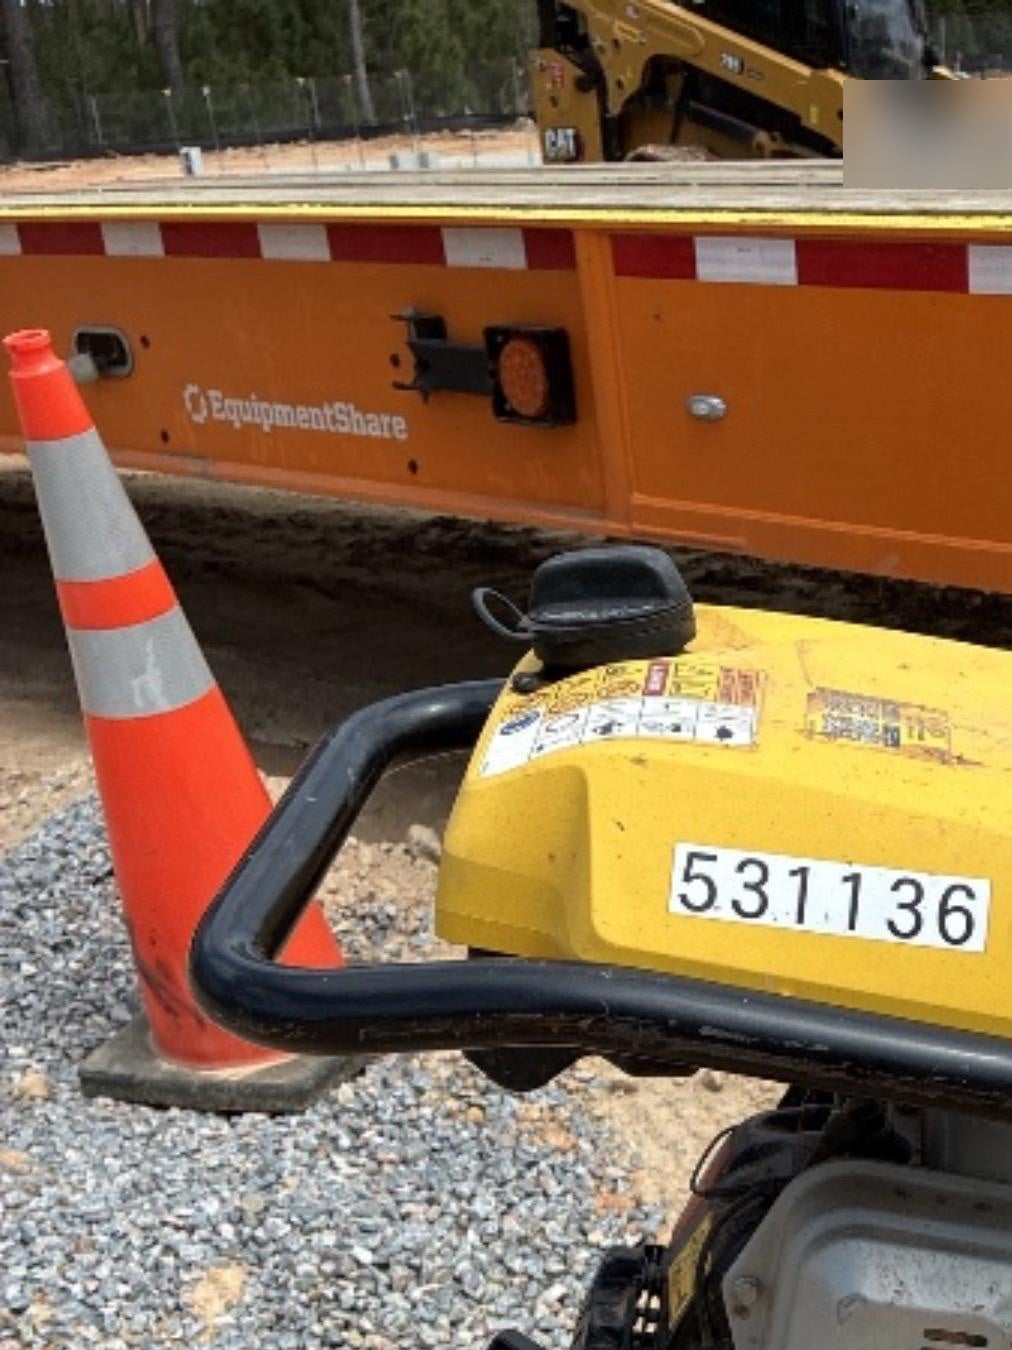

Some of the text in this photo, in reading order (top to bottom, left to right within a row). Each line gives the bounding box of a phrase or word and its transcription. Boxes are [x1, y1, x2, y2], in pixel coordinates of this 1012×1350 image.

[544, 128, 577, 158] CAT
[207, 389, 409, 440] EquipmentShare
[677, 851, 977, 946] 531136
